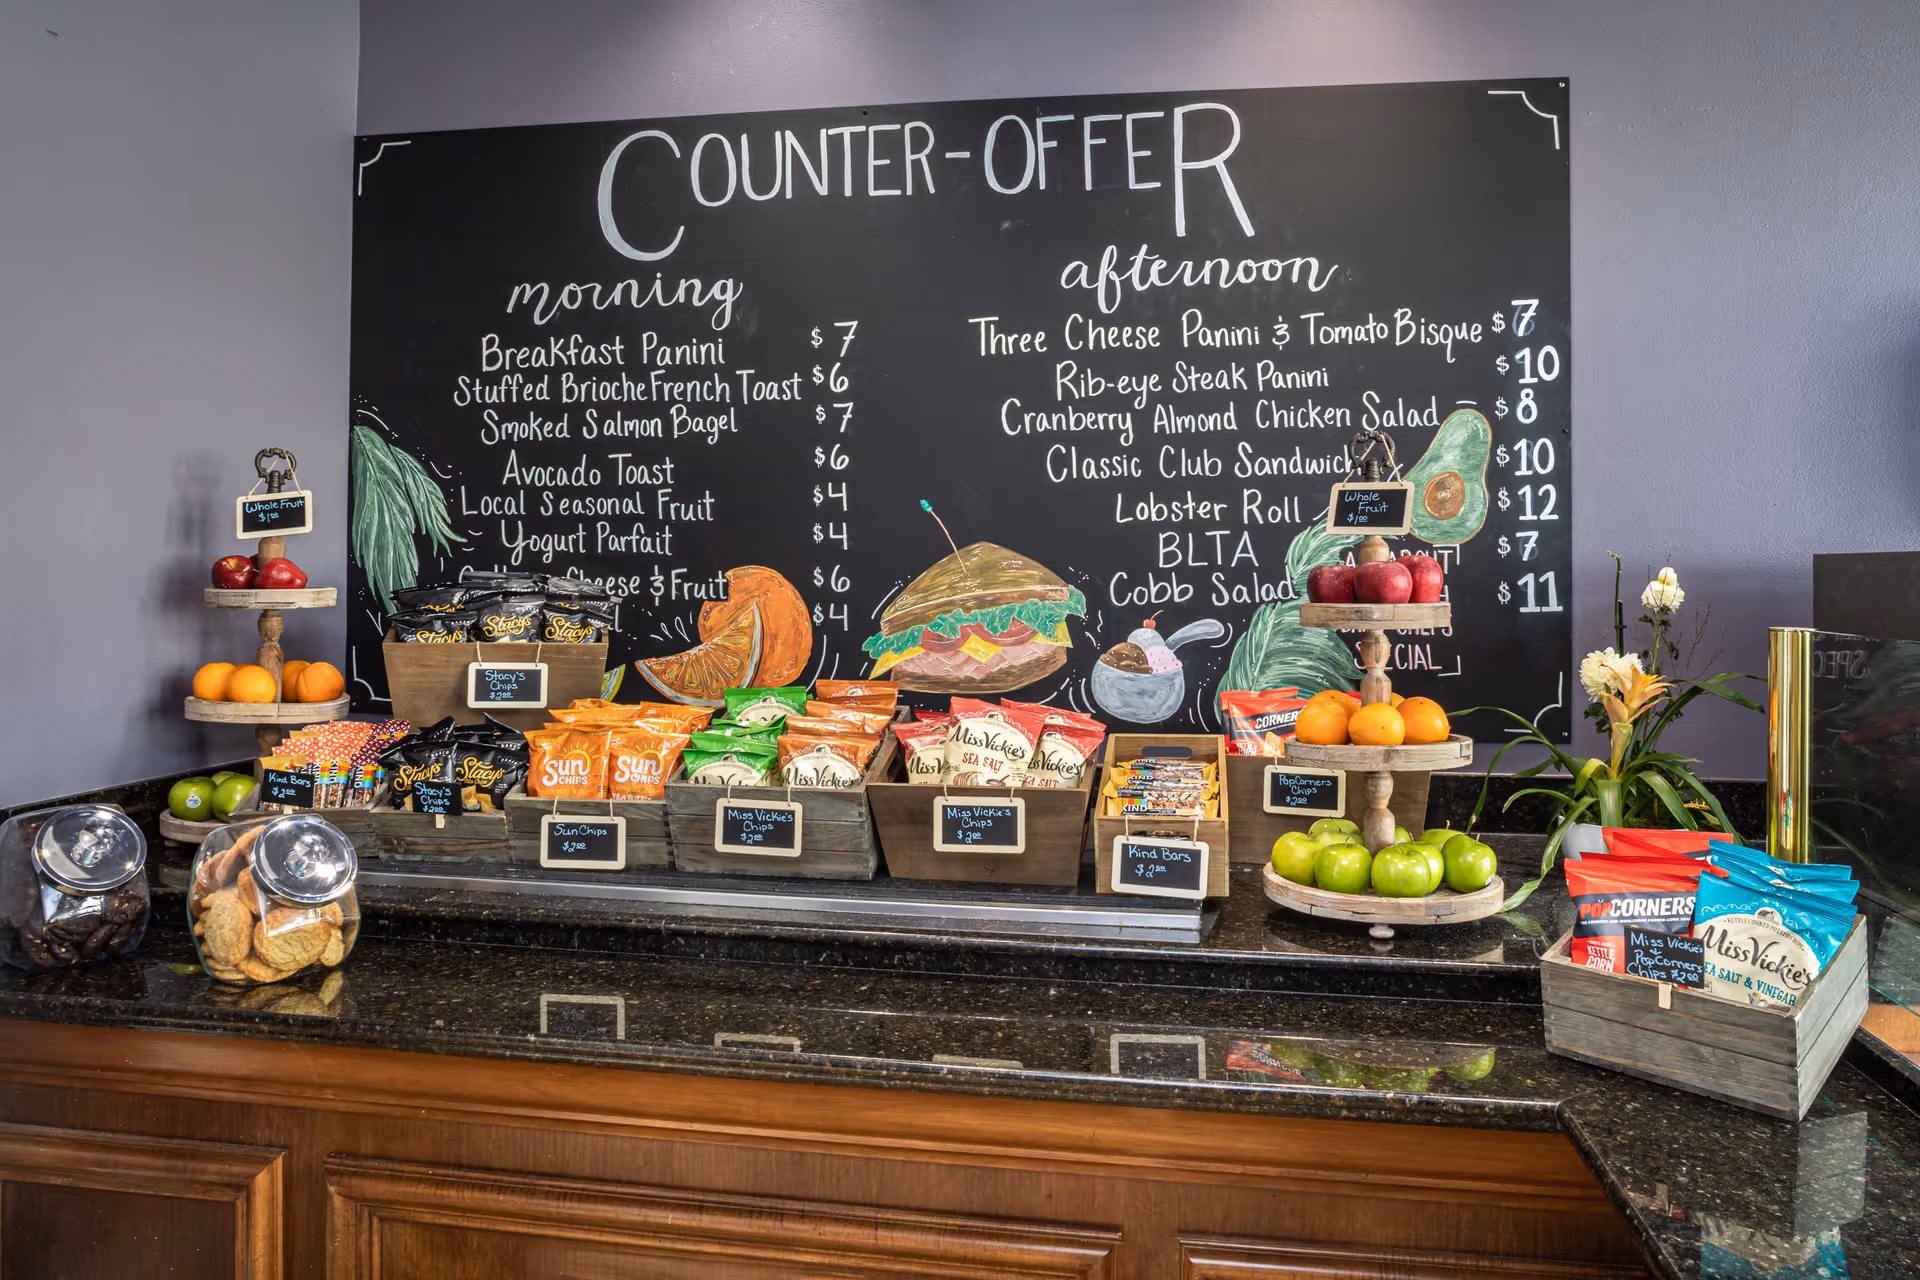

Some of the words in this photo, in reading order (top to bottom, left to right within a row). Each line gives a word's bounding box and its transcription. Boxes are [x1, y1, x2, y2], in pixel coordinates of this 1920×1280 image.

[1061, 244, 1338, 313] afternoon
[507, 273, 743, 330] morning
[969, 317, 1047, 356] Three
[1065, 314, 1160, 350] Cheese
[1182, 309, 1259, 347] Panini
[1300, 312, 1388, 345] Tomato
[1394, 308, 1482, 363] Bisque
[482, 334, 624, 371] Breakfast
[643, 332, 725, 366] Panini
[454, 374, 550, 406] Stuffed
[562, 373, 647, 403] Brioche
[651, 370, 730, 402] French
[736, 370, 802, 404] Toast
[1057, 360, 1162, 409] Rib-eye
[1172, 361, 1247, 393] Steak
[1257, 360, 1329, 391] Panini
[482, 410, 570, 444] Smoked
[583, 409, 662, 438] Salmon
[670, 404, 737, 444] Bagel
[1001, 398, 1133, 446] Cranberry
[1154, 402, 1237, 434] Almond
[1256, 399, 1350, 428] Chicken
[1362, 391, 1440, 430] Salad
[503, 450, 600, 486] Avocado
[609, 453, 674, 485] Toast
[1047, 445, 1141, 482] Classic
[1160, 445, 1221, 478] Club
[1235, 442, 1361, 478] Sandwich
[245, 501, 278, 514] Whole
[280, 499, 305, 510] Fruit
[462, 486, 525, 515] Local
[541, 491, 644, 515] Seasonal
[658, 489, 714, 520] Fruit
[1116, 491, 1227, 523] Lobster
[1243, 489, 1301, 524] Roll
[1344, 491, 1380, 502] Whole
[1357, 501, 1389, 514] Fruit
[502, 520, 586, 565] Yogurt
[597, 522, 672, 555] Parfait
[1159, 531, 1259, 567] BLTA
[672, 569, 727, 599] Fruit
[1110, 572, 1193, 606] Cobb
[1212, 573, 1298, 605] Salad
[485, 669, 526, 684] Stacy's
[489, 681, 519, 691] Chips
[949, 725, 984, 749] Miss
[983, 731, 1027, 761] Vickie's
[455, 756, 506, 788] Stacy's
[541, 759, 591, 787] Sun
[613, 756, 664, 783] Sun
[908, 757, 937, 775] Miss
[962, 752, 979, 765] SEA
[983, 756, 1004, 773] SALT
[1040, 749, 1081, 779] Vickie's
[268, 772, 288, 784] Kind
[290, 775, 312, 788] Bars
[414, 781, 452, 797] Stacy's
[558, 776, 588, 785] CHIPS
[630, 773, 660, 785] CHIPS
[1291, 785, 1318, 796] Chips
[420, 795, 450, 806] Chips
[1122, 804, 1148, 813] KIND
[728, 809, 754, 821] Miss
[755, 808, 794, 823] Vickie's
[947, 808, 972, 819] Miss
[973, 807, 1011, 817] Vickie's
[961, 817, 993, 828] Chips
[743, 821, 774, 832] Chips
[1128, 845, 1158, 860] Kind
[1160, 848, 1192, 863] Bars
[1586, 945, 1616, 960] KETTLE
[1631, 931, 1665, 948] Miss
[1667, 936, 1704, 954] Vickie's
[1789, 935, 1804, 949] CHIPS
[1586, 956, 1614, 973] CORN
[1634, 949, 1703, 974] PopCorners
[1701, 924, 1750, 963] Miss
[1748, 936, 1813, 991] Vickie's
[1626, 962, 1667, 980] Chips
[1703, 961, 1716, 977] EA
[1718, 967, 1743, 984] SALT
[1744, 976, 1753, 990] &
[1757, 979, 1797, 1007] VINEGAR
